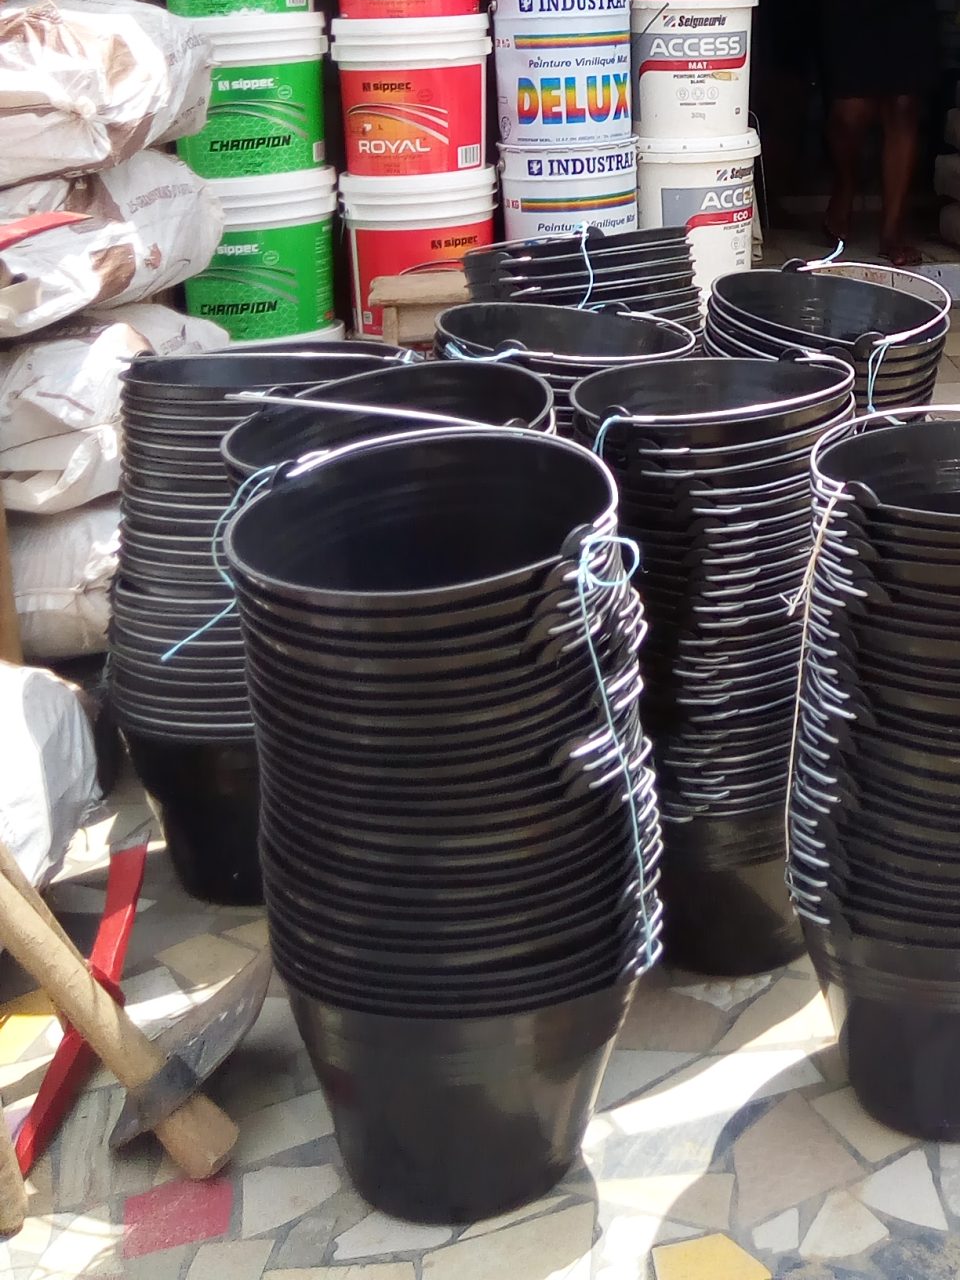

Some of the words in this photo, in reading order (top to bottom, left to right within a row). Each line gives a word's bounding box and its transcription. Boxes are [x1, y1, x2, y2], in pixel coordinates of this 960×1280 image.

[678, 14, 726, 28] Seigneurie
[650, 36, 741, 57] ACCESS
[688, 61, 707, 69] MAT
[231, 78, 274, 90] sippec
[373, 81, 412, 92] sippec
[209, 134, 291, 153] CHAMPION
[358, 138, 431, 154] ROYAL
[700, 184, 752, 211] ACCE
[733, 210, 748, 222] ECO
[537, 222, 577, 233] Peintu
[444, 235, 477, 248] sippec
[200, 300, 278, 316] CHAMPION
